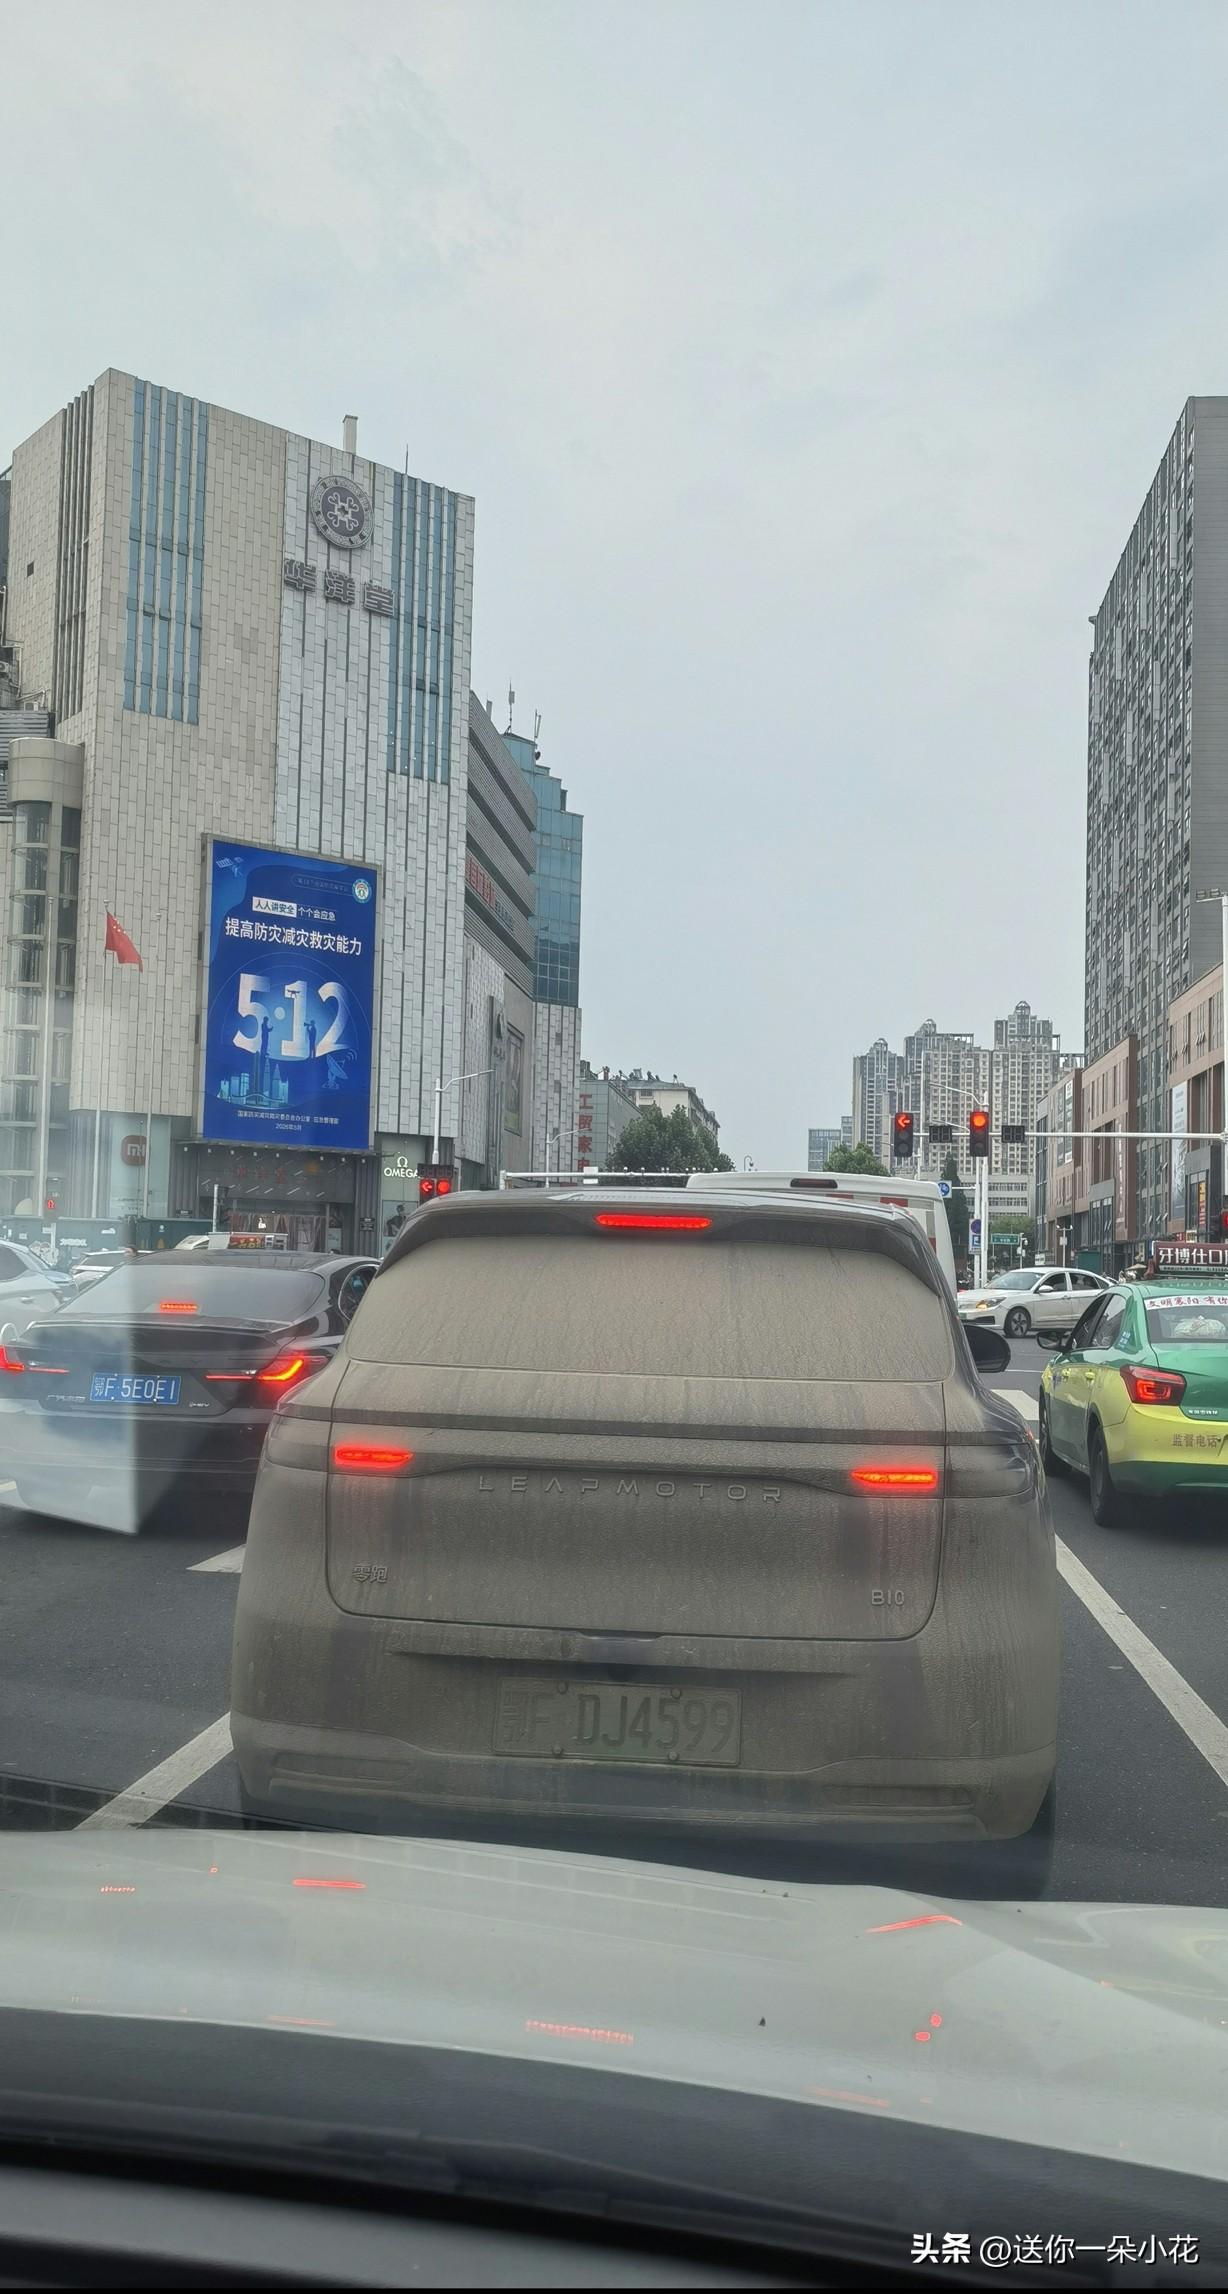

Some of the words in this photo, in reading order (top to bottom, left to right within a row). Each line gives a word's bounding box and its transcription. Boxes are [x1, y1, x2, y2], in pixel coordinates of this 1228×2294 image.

[283, 559, 395, 616] 华洋堂
[255, 899, 295, 915] 人人讲安全
[298, 906, 336, 921] 个个会应急
[225, 917, 362, 956] 提高防灾减灾救灾能力
[384, 1167, 421, 1178] OMEGA
[1159, 1247, 1228, 1265] 牙博仕口
[1172, 1434, 1217, 1448] 监督电话
[479, 1475, 782, 1502] LEAPMOTOR
[352, 1562, 388, 1584] 零跑
[871, 1589, 905, 1606] B10
